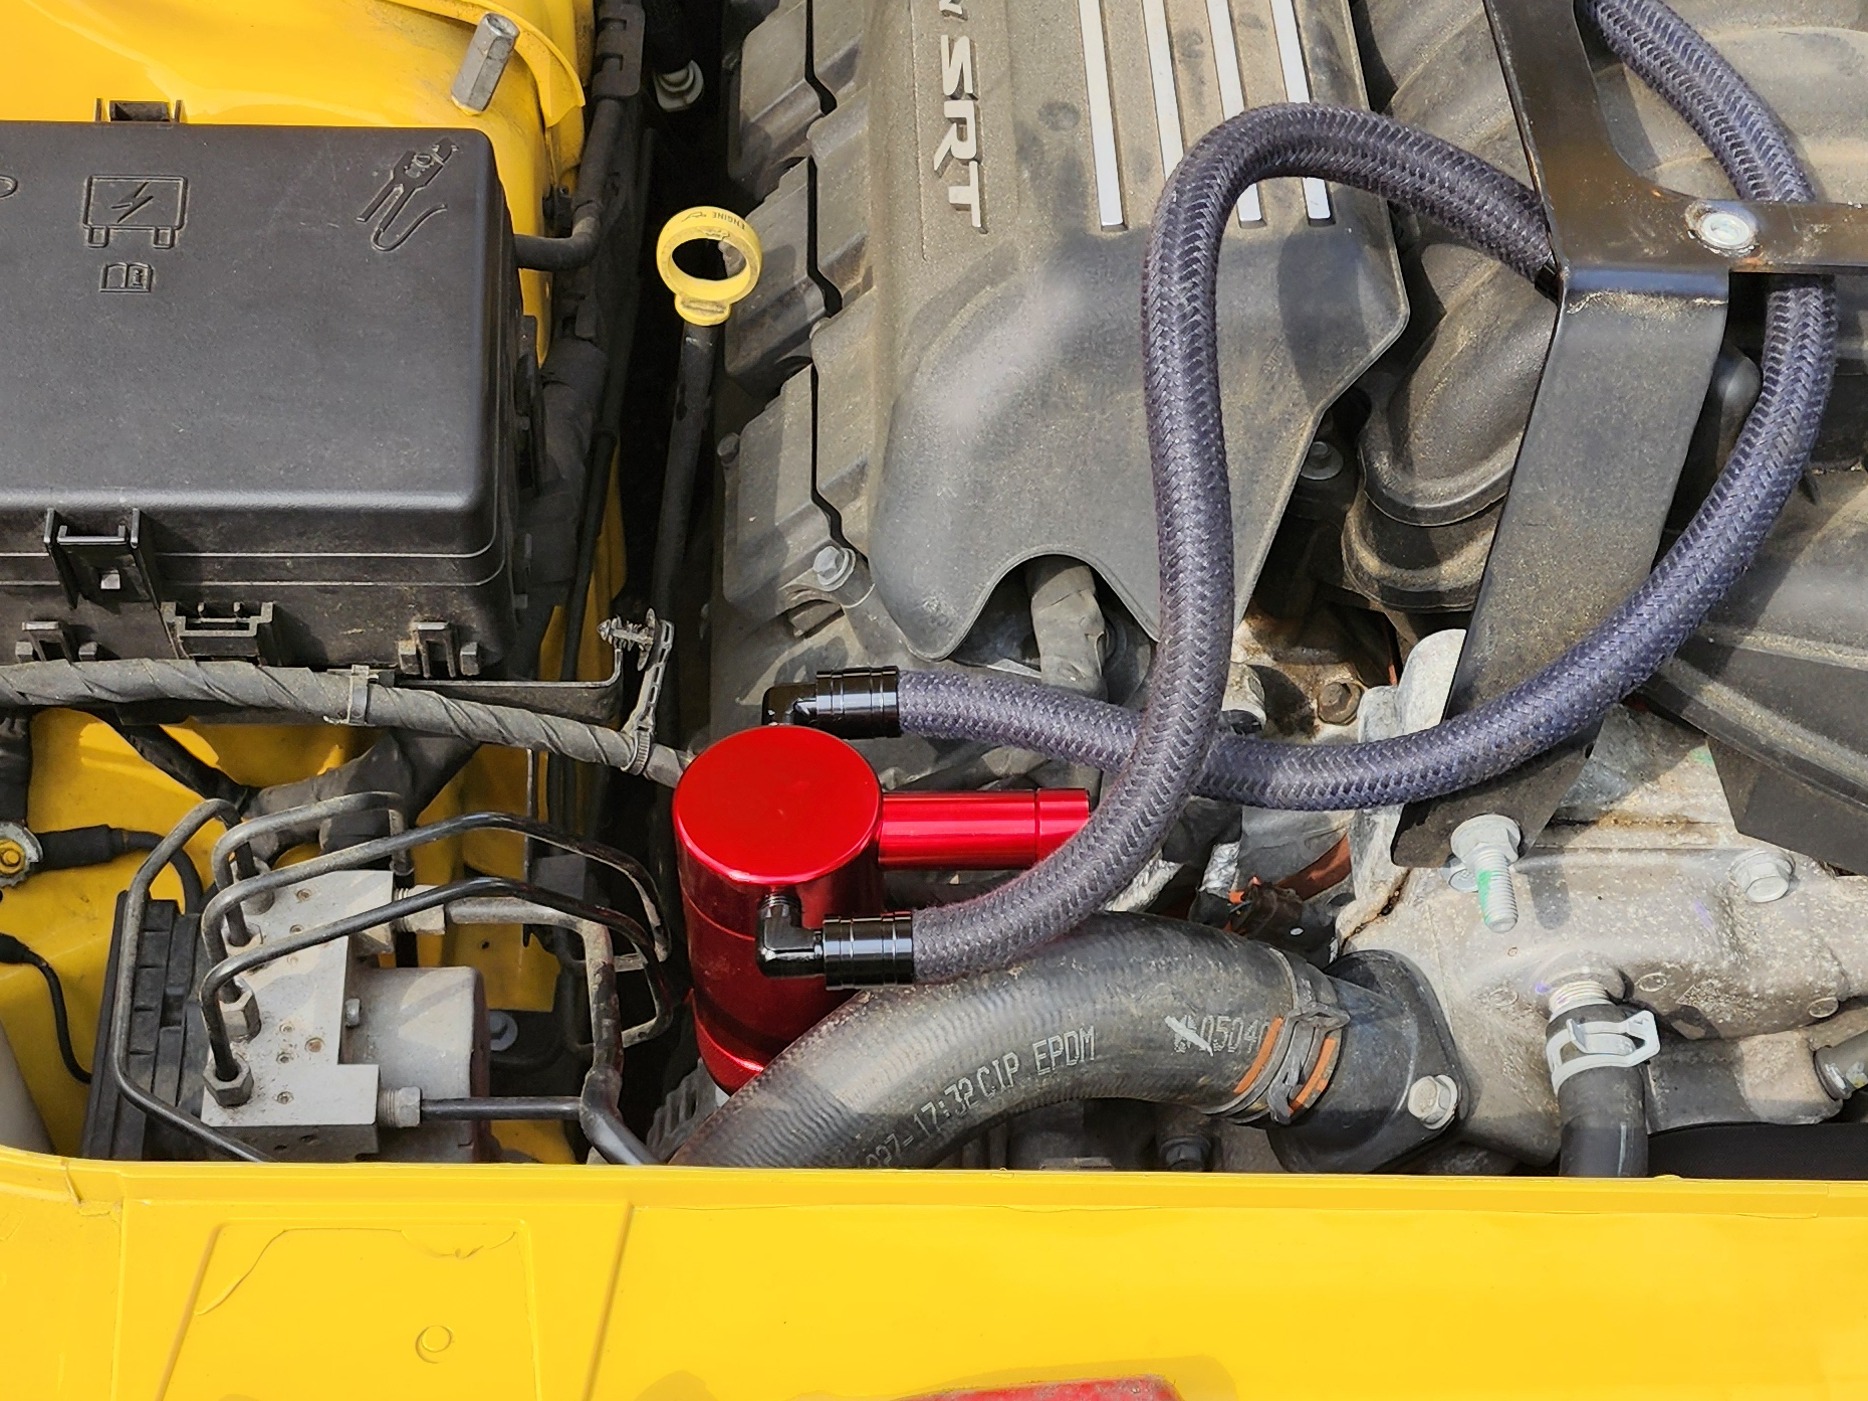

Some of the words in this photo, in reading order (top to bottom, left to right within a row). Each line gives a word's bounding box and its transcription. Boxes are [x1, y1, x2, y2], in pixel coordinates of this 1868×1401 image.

[934, 34, 982, 228] SRT
[711, 210, 747, 231] ENGINE
[1031, 1024, 1096, 1076] EPDM
